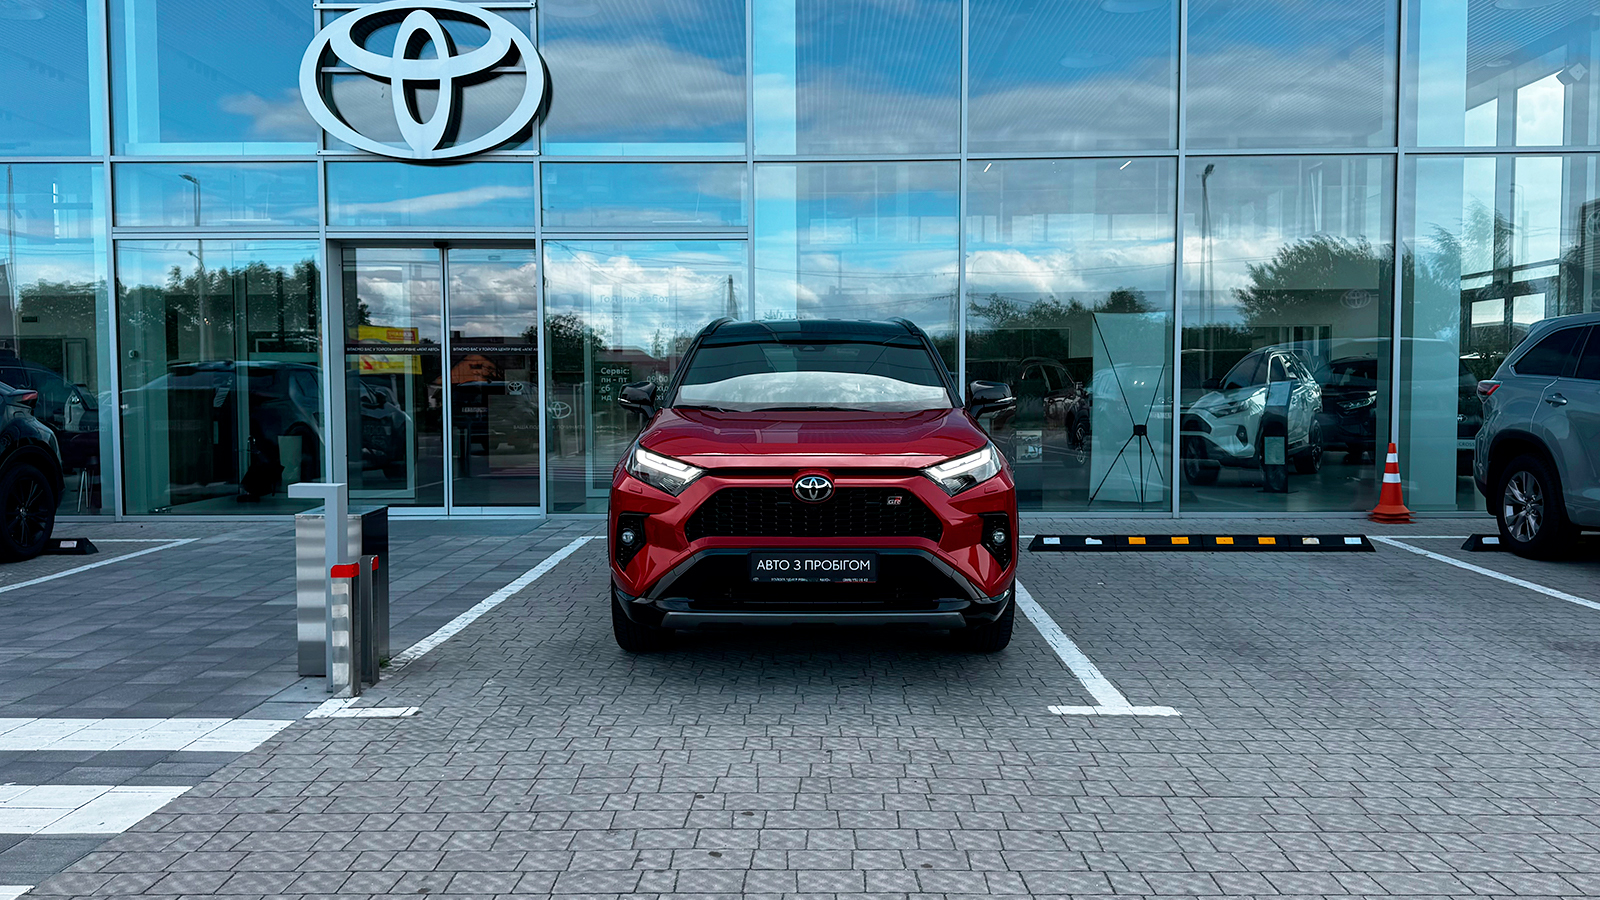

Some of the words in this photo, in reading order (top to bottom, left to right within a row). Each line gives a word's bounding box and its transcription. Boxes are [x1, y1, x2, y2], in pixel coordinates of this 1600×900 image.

[600, 295, 637, 305] Годни
[639, 294, 670, 305] робот
[600, 367, 630, 376] Сервіс:
[646, 375, 669, 383] 09:00
[601, 384, 611, 392] сб
[886, 496, 903, 506] GR
[756, 559, 790, 571] АВТО
[804, 559, 871, 571] ПРОБІГОМ
